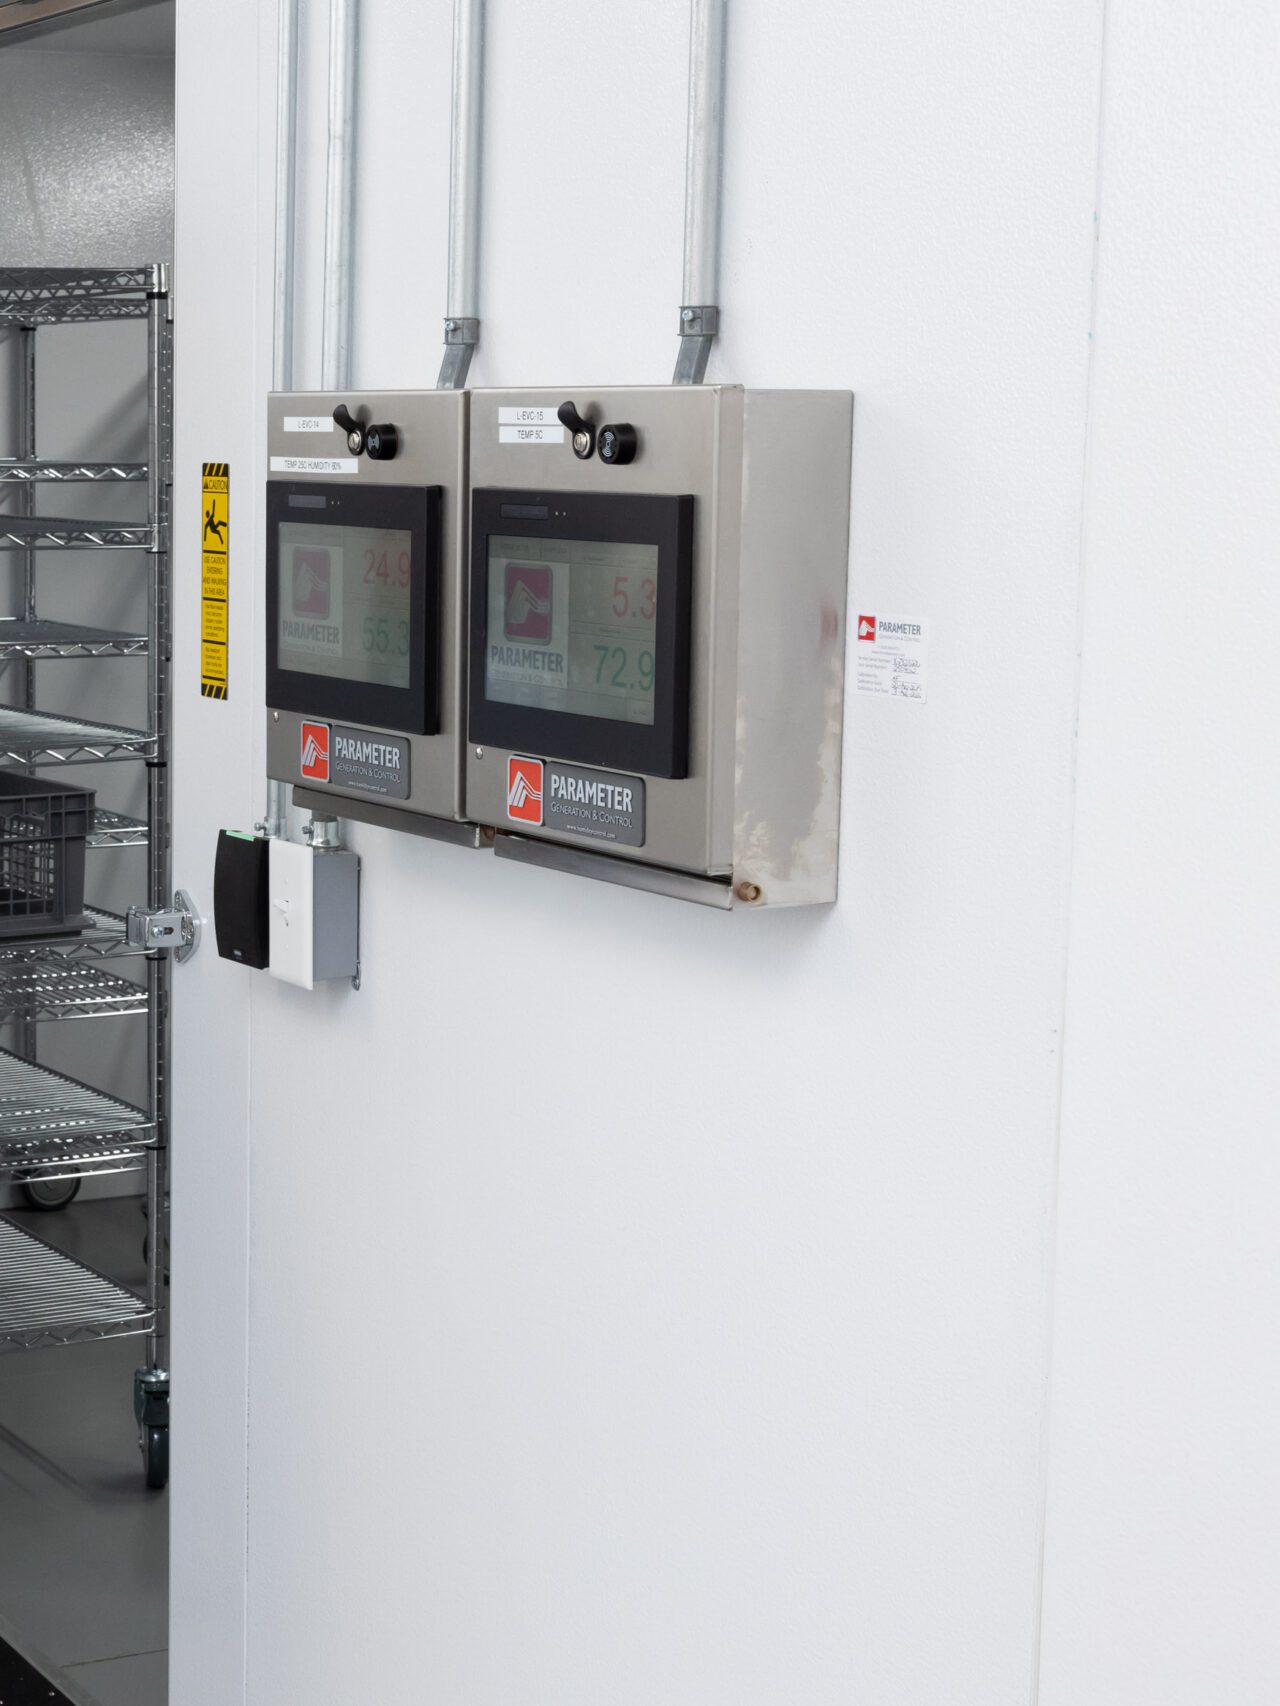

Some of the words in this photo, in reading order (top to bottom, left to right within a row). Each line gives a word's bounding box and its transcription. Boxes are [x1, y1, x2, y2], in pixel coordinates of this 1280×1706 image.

[297, 420, 320, 429] L-EVC-14
[516, 410, 544, 421] L-EVC-15
[517, 430, 534, 440] TEMP
[535, 430, 544, 440] 5C
[284, 460, 298, 469] TEMP
[307, 461, 331, 471] HUMIDITY
[208, 479, 228, 491] CAUTION
[362, 549, 411, 588] 24.9
[612, 575, 657, 620] 5.3
[282, 620, 340, 645] PARAMETER
[362, 616, 410, 656] 55.3
[878, 621, 921, 636] PARAMETER
[491, 644, 564, 673] PARAMETER
[593, 643, 654, 692] 72.9
[335, 736, 401, 769] PARAMETER
[336, 761, 368, 776] GENERATION
[368, 769, 373, 777] &
[374, 768, 401, 783] CONTROL
[550, 774, 633, 813] PARAMETER
[551, 801, 591, 819] GENERATION
[592, 810, 598, 821] &
[599, 811, 633, 828] CONTROL
